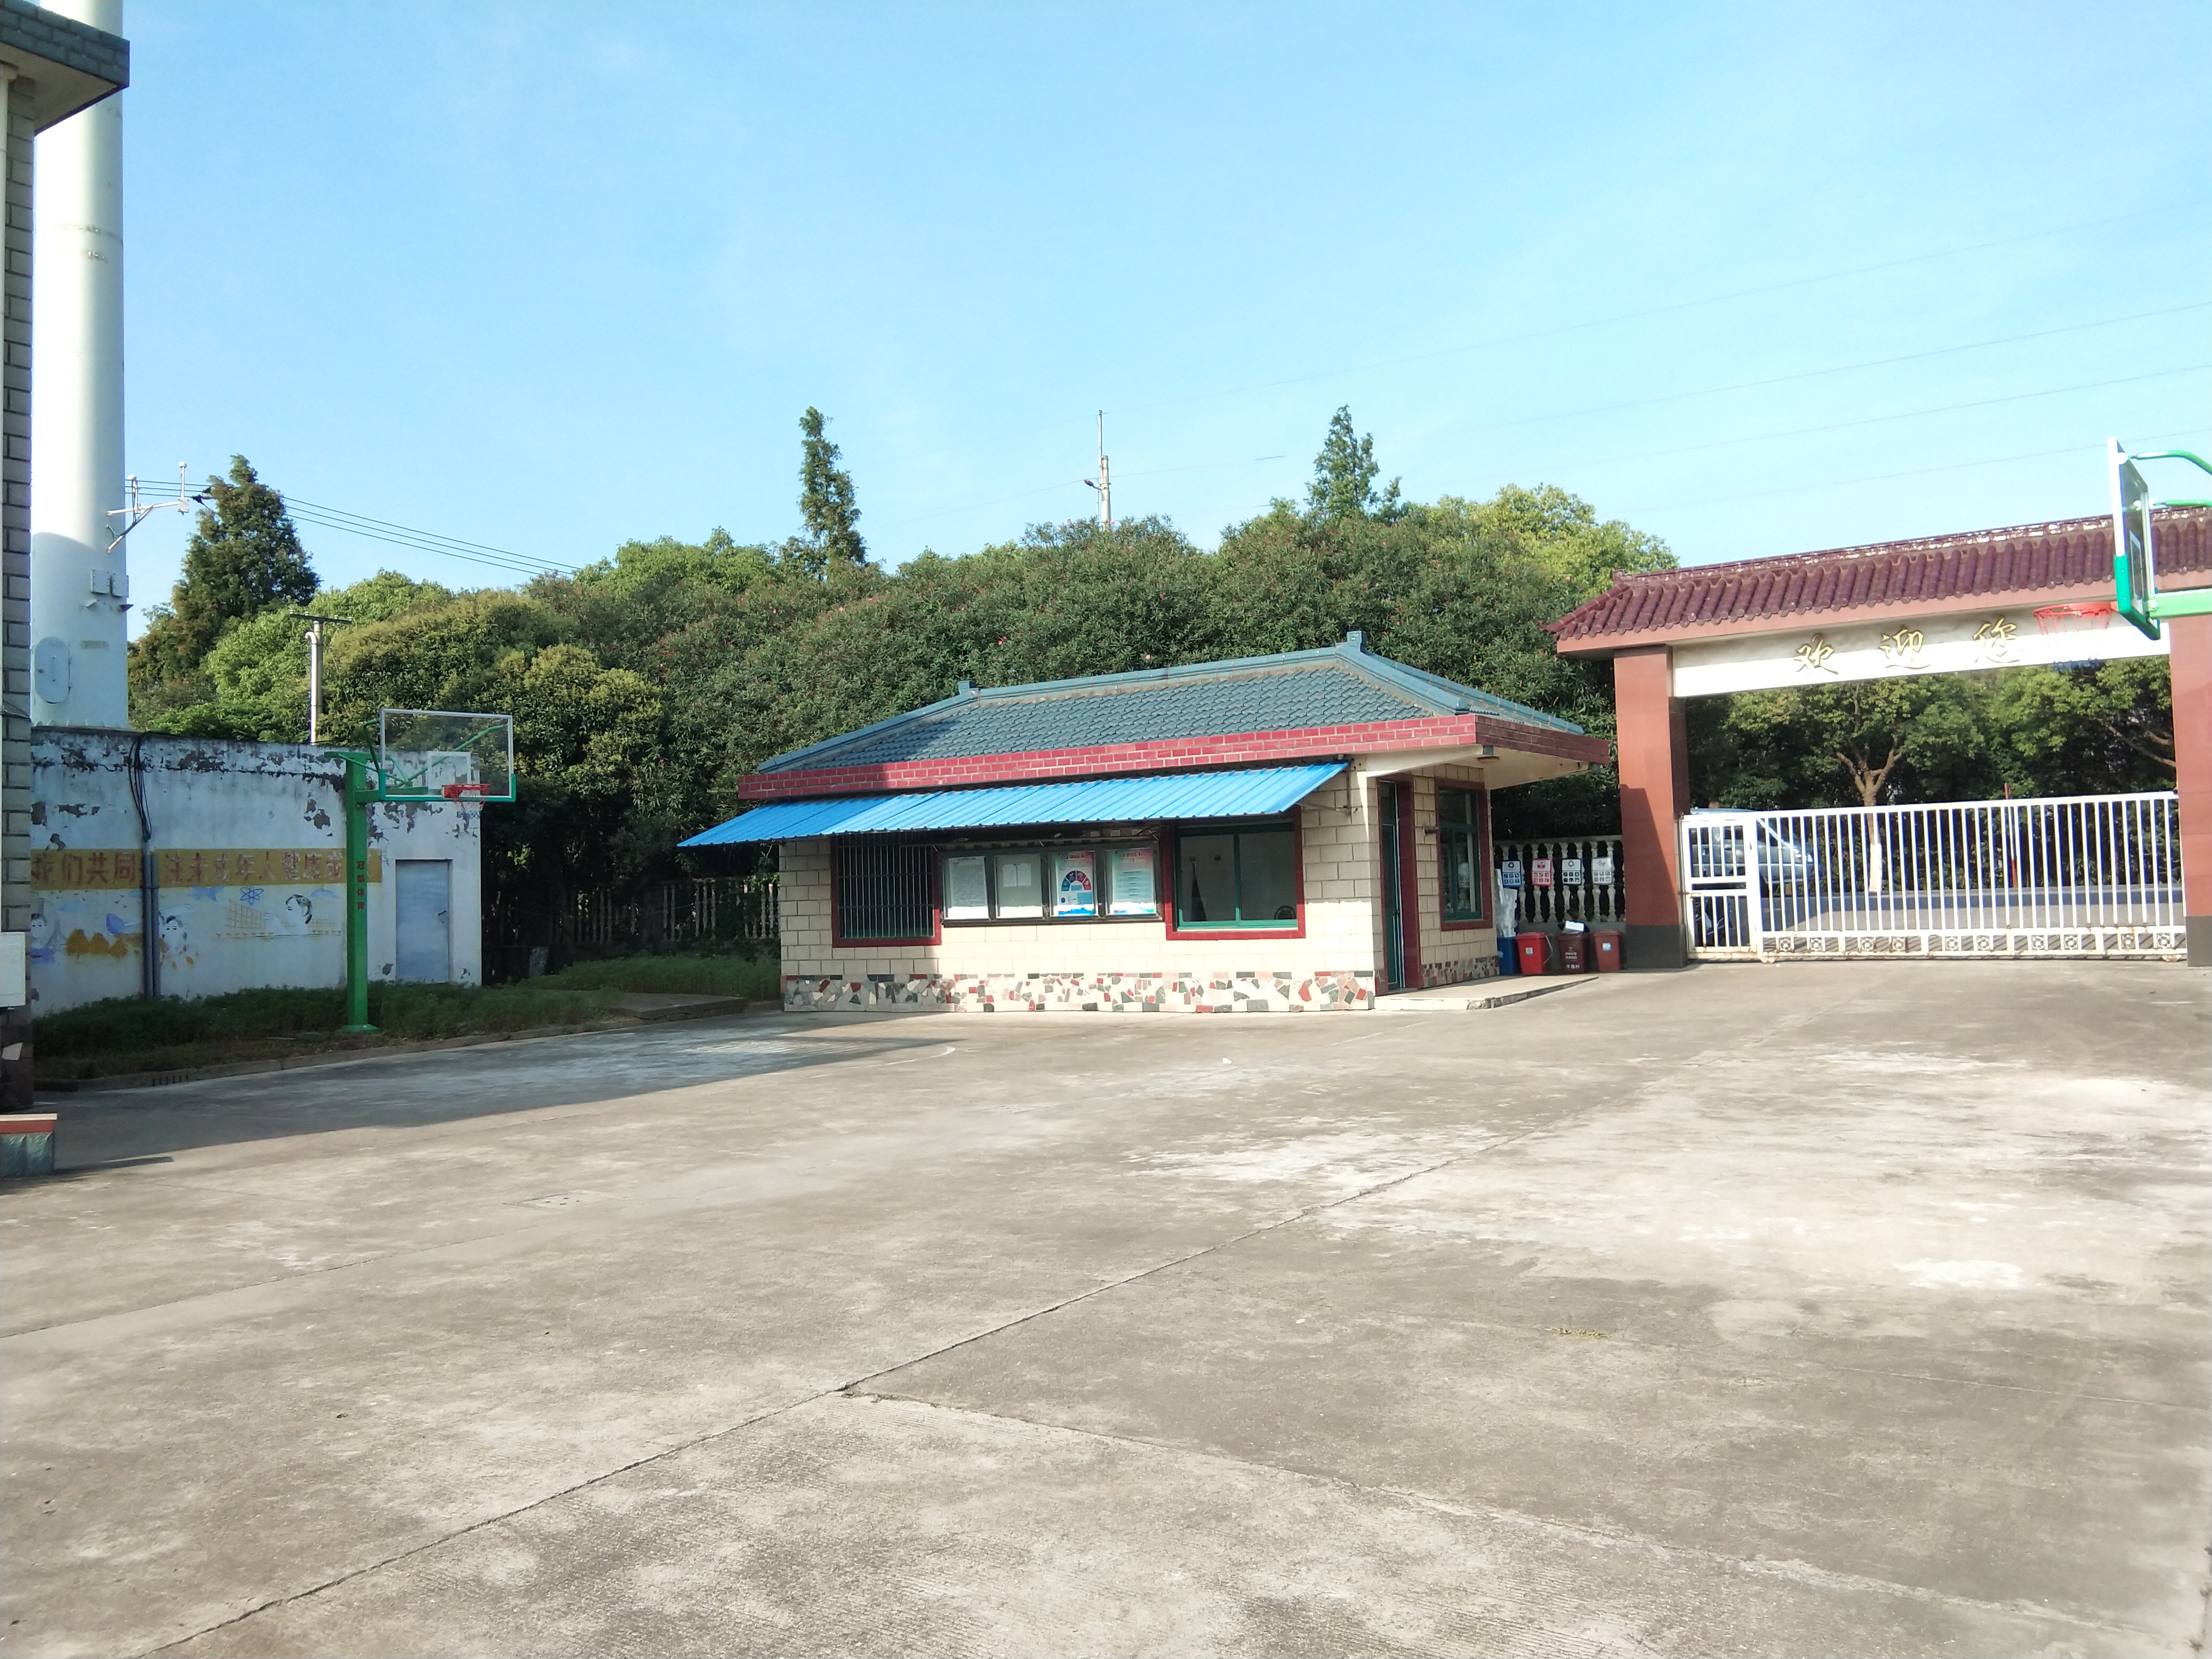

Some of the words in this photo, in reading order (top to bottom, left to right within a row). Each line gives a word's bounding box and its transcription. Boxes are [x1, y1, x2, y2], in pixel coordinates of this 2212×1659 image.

[1794, 615, 2025, 675] 欢迎您
[31, 851, 372, 884] 我们共同注未成年人健康成
